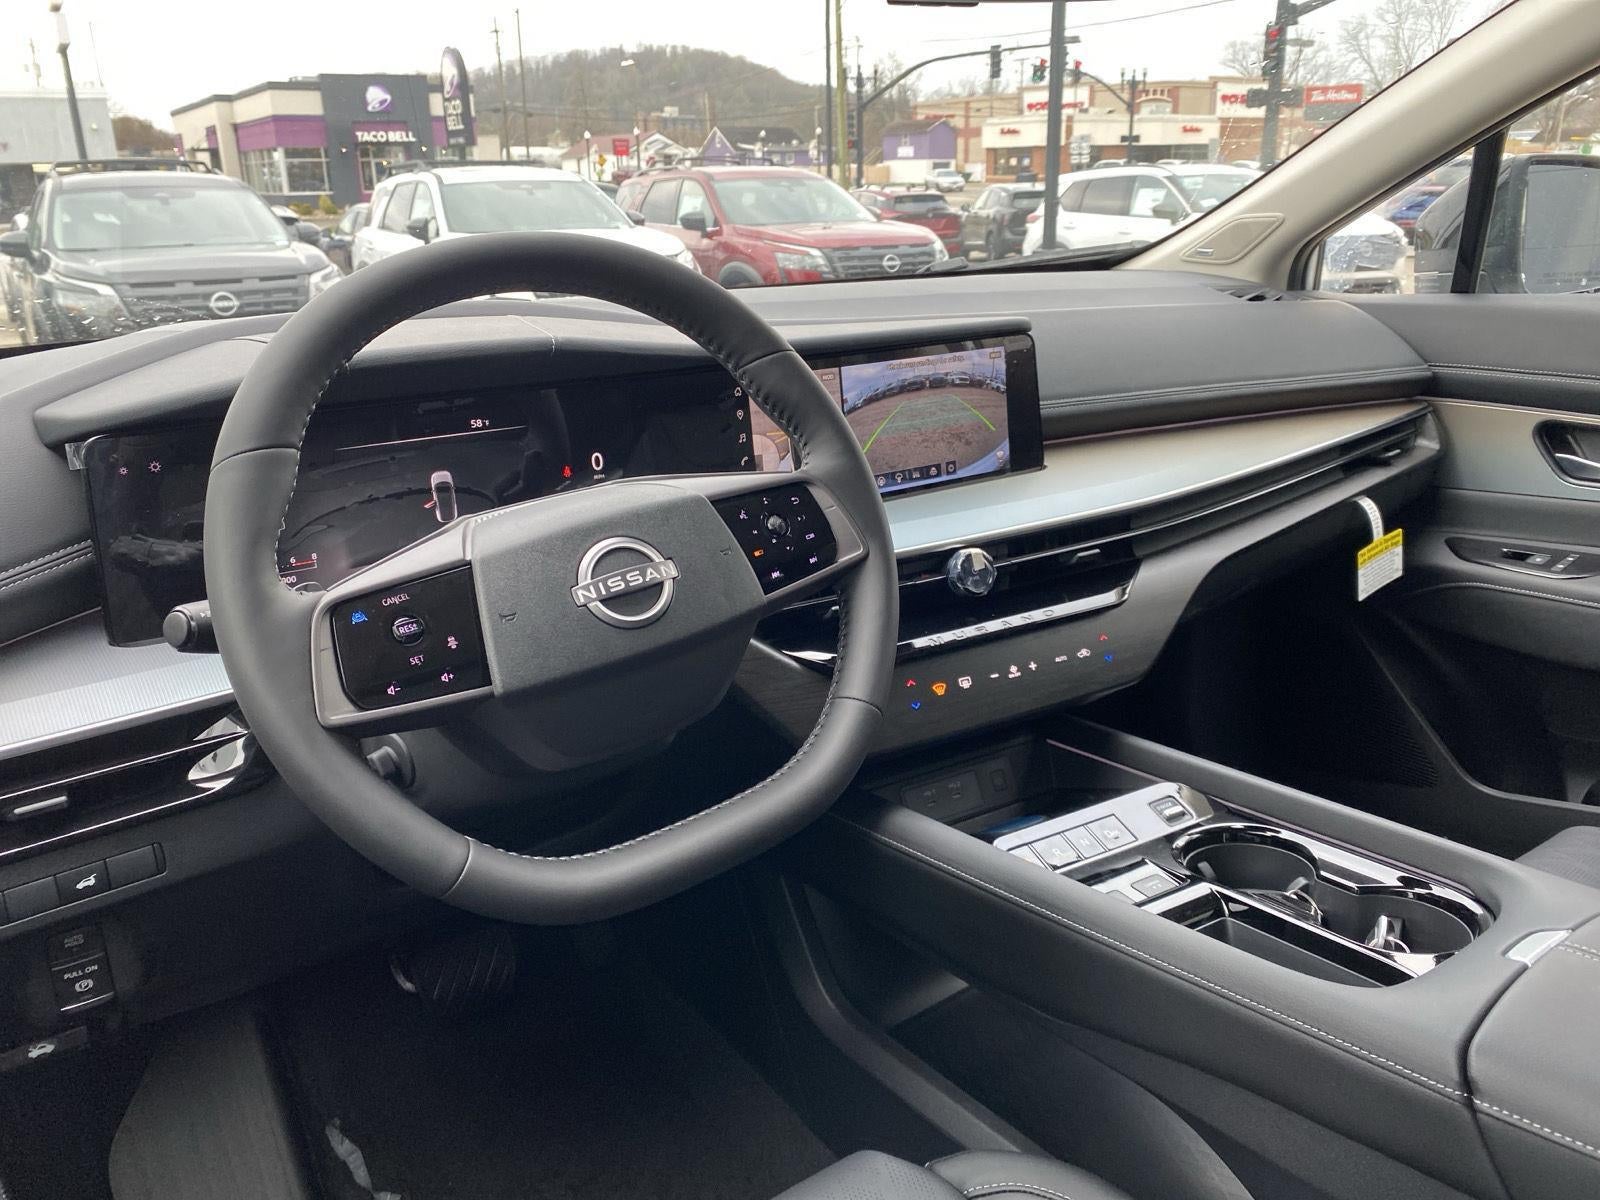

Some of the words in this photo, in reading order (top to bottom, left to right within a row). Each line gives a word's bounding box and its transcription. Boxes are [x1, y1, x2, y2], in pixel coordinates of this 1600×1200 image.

[355, 131, 387, 142] TACO
[388, 131, 416, 142] BELL
[591, 452, 603, 471] 0
[576, 563, 676, 603] NISSAN
[381, 593, 410, 606] CANCEL
[928, 609, 1055, 646] MURANO
[409, 655, 424, 665] SET
[64, 970, 83, 979] PULL
[85, 964, 98, 973] ON
